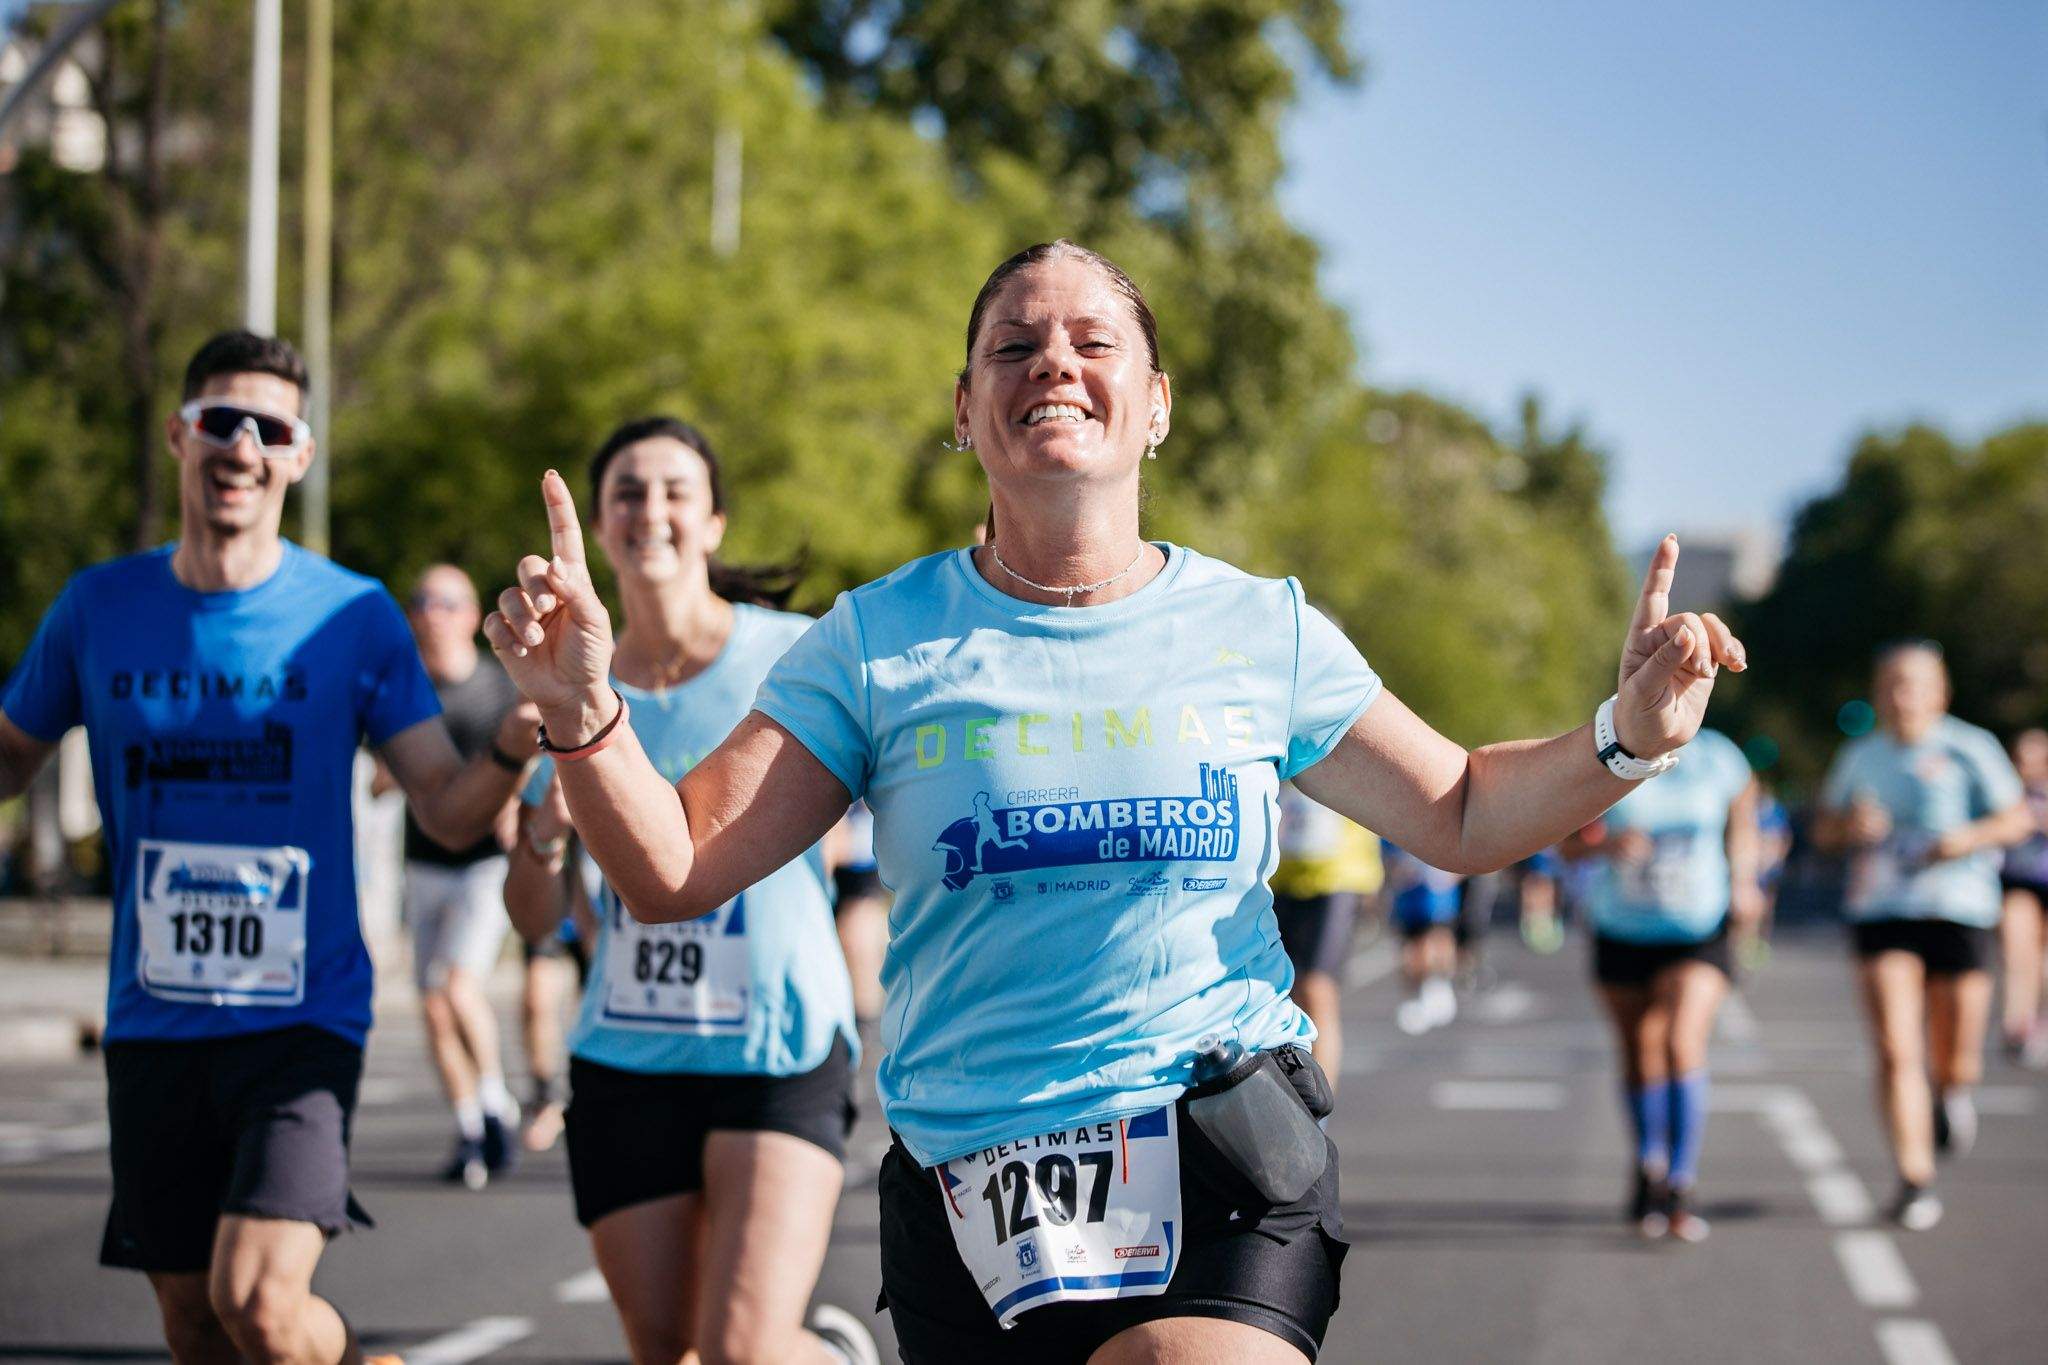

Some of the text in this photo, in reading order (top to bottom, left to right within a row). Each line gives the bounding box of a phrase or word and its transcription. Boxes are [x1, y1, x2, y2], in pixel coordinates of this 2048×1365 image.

[111, 666, 307, 700] DECIMAS
[915, 703, 1255, 769] DECIMAS
[1007, 786, 1080, 805] CARRERA
[1007, 800, 1233, 837] BOMBEROS
[1099, 827, 1234, 859] de MADRID
[1055, 879, 1111, 892] MADRID
[170, 912, 264, 959] 1310
[635, 938, 705, 986] 829
[982, 1150, 1114, 1246] 1297
